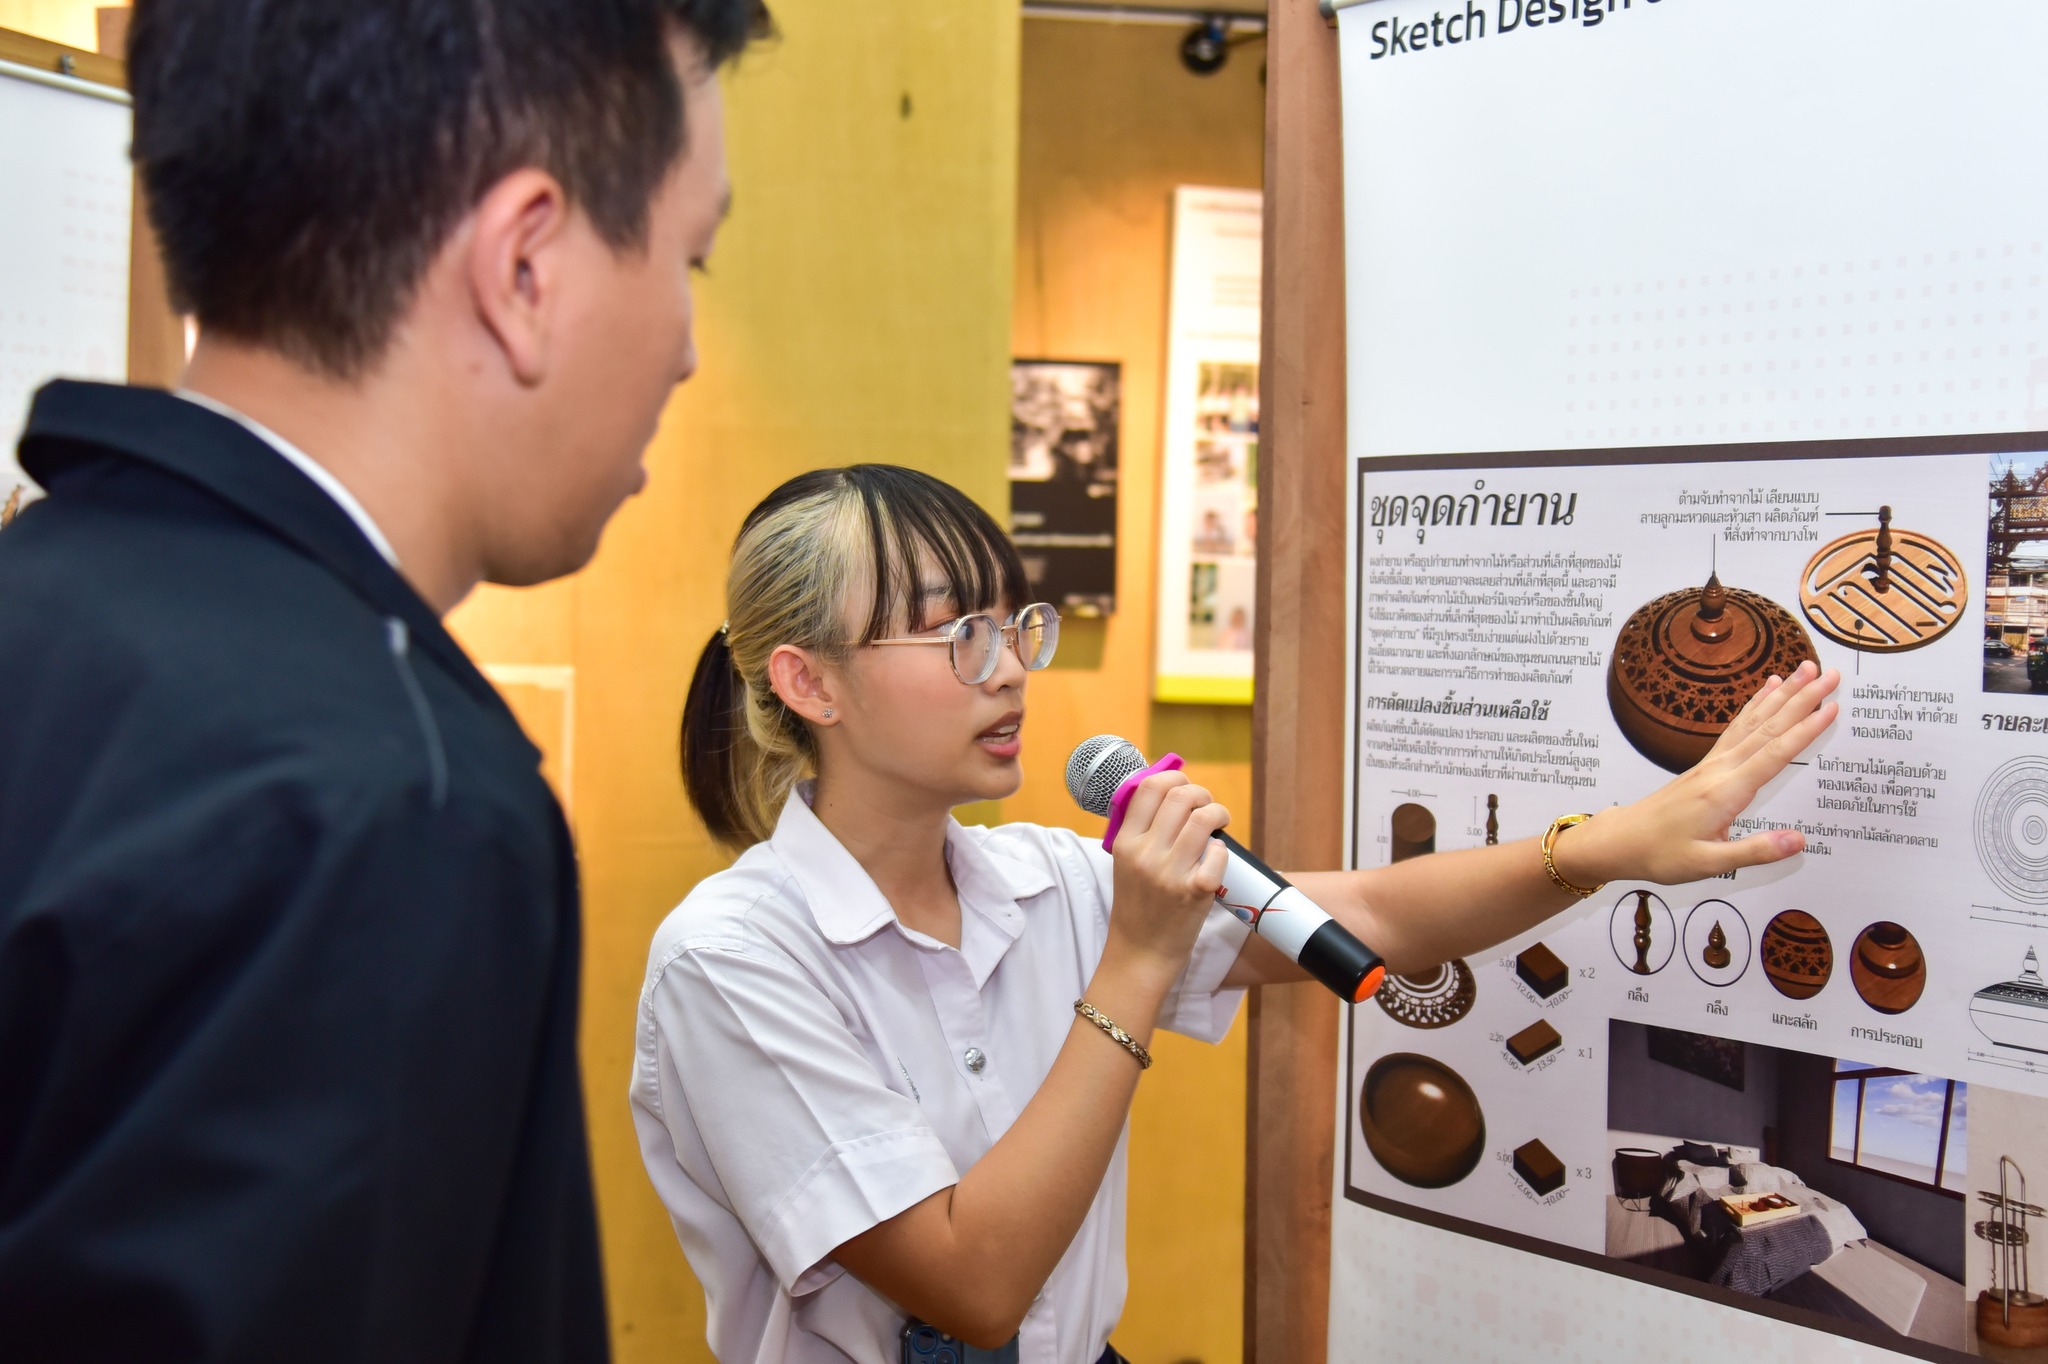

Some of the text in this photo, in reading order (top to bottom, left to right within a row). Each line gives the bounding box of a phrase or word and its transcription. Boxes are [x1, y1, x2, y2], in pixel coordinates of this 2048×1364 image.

[1370, 1, 1486, 60] Sketch
[1679, 488, 1820, 505] ด้ามจับทำจากไม้ เลียนแบบ
[1371, 479, 1578, 545] ชุดจุดกำยาน
[1764, 506, 1819, 523] ผลิตภัณฑ์
[1571, 573, 1617, 588] และอาจมี
[1521, 611, 1613, 628] มาทำเป็นผลิตภัณฑ์
[1852, 684, 1954, 704] แม่พิมพ์กำยานผง
[1367, 690, 1552, 721] การดัดแปลงชิ้นส่วนเหลือใช้
[1851, 704, 1958, 724] ลายบางโพ ทำด้วย
[1466, 727, 1504, 743] ประกอบ
[1851, 724, 1913, 741] ทองเหลือง
[1817, 754, 1947, 780] โถกำยานไม้เคลือบด้วย
[1817, 775, 1936, 799] ทองเหลือง เพื่อความ
[1816, 795, 1918, 818] ปลอดภัยในการใช้
[1466, 827, 1483, 837] 5.00
[1627, 987, 1650, 1004] กลึง
[1706, 1000, 1729, 1017] กลึง
[1772, 1011, 1819, 1032] แกะสลัก
[1850, 1024, 1924, 1050] การประกอบ
